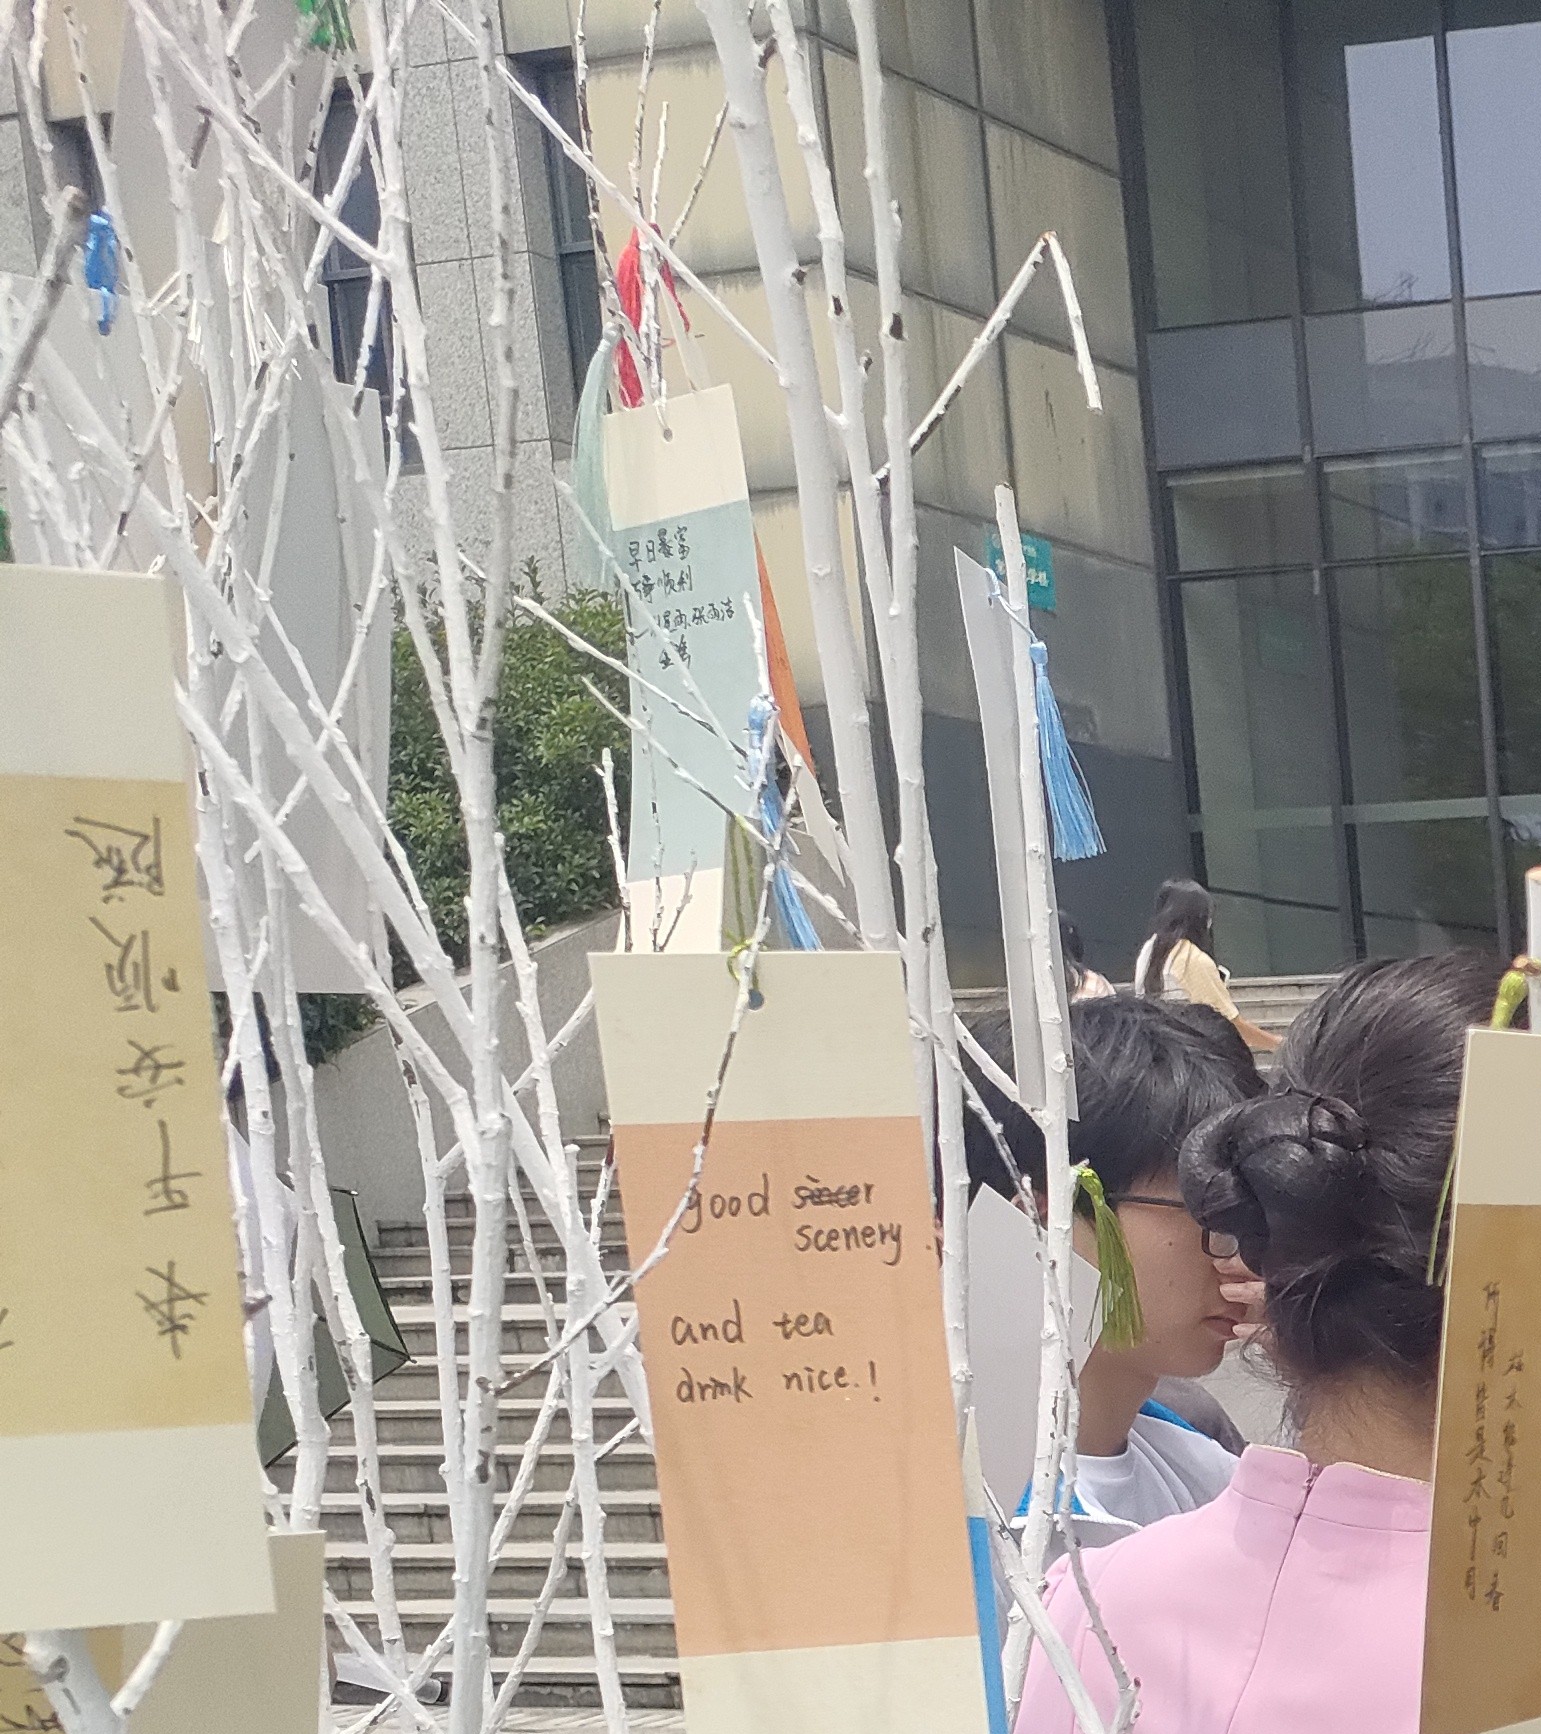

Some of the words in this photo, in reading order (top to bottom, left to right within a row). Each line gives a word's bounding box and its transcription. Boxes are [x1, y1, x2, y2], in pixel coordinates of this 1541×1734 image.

[628, 525, 691, 572] 早日暴富
[680, 1173, 770, 1234] good
[794, 1222, 903, 1267] scenery
[671, 1299, 746, 1346] and
[771, 1311, 835, 1341] tea
